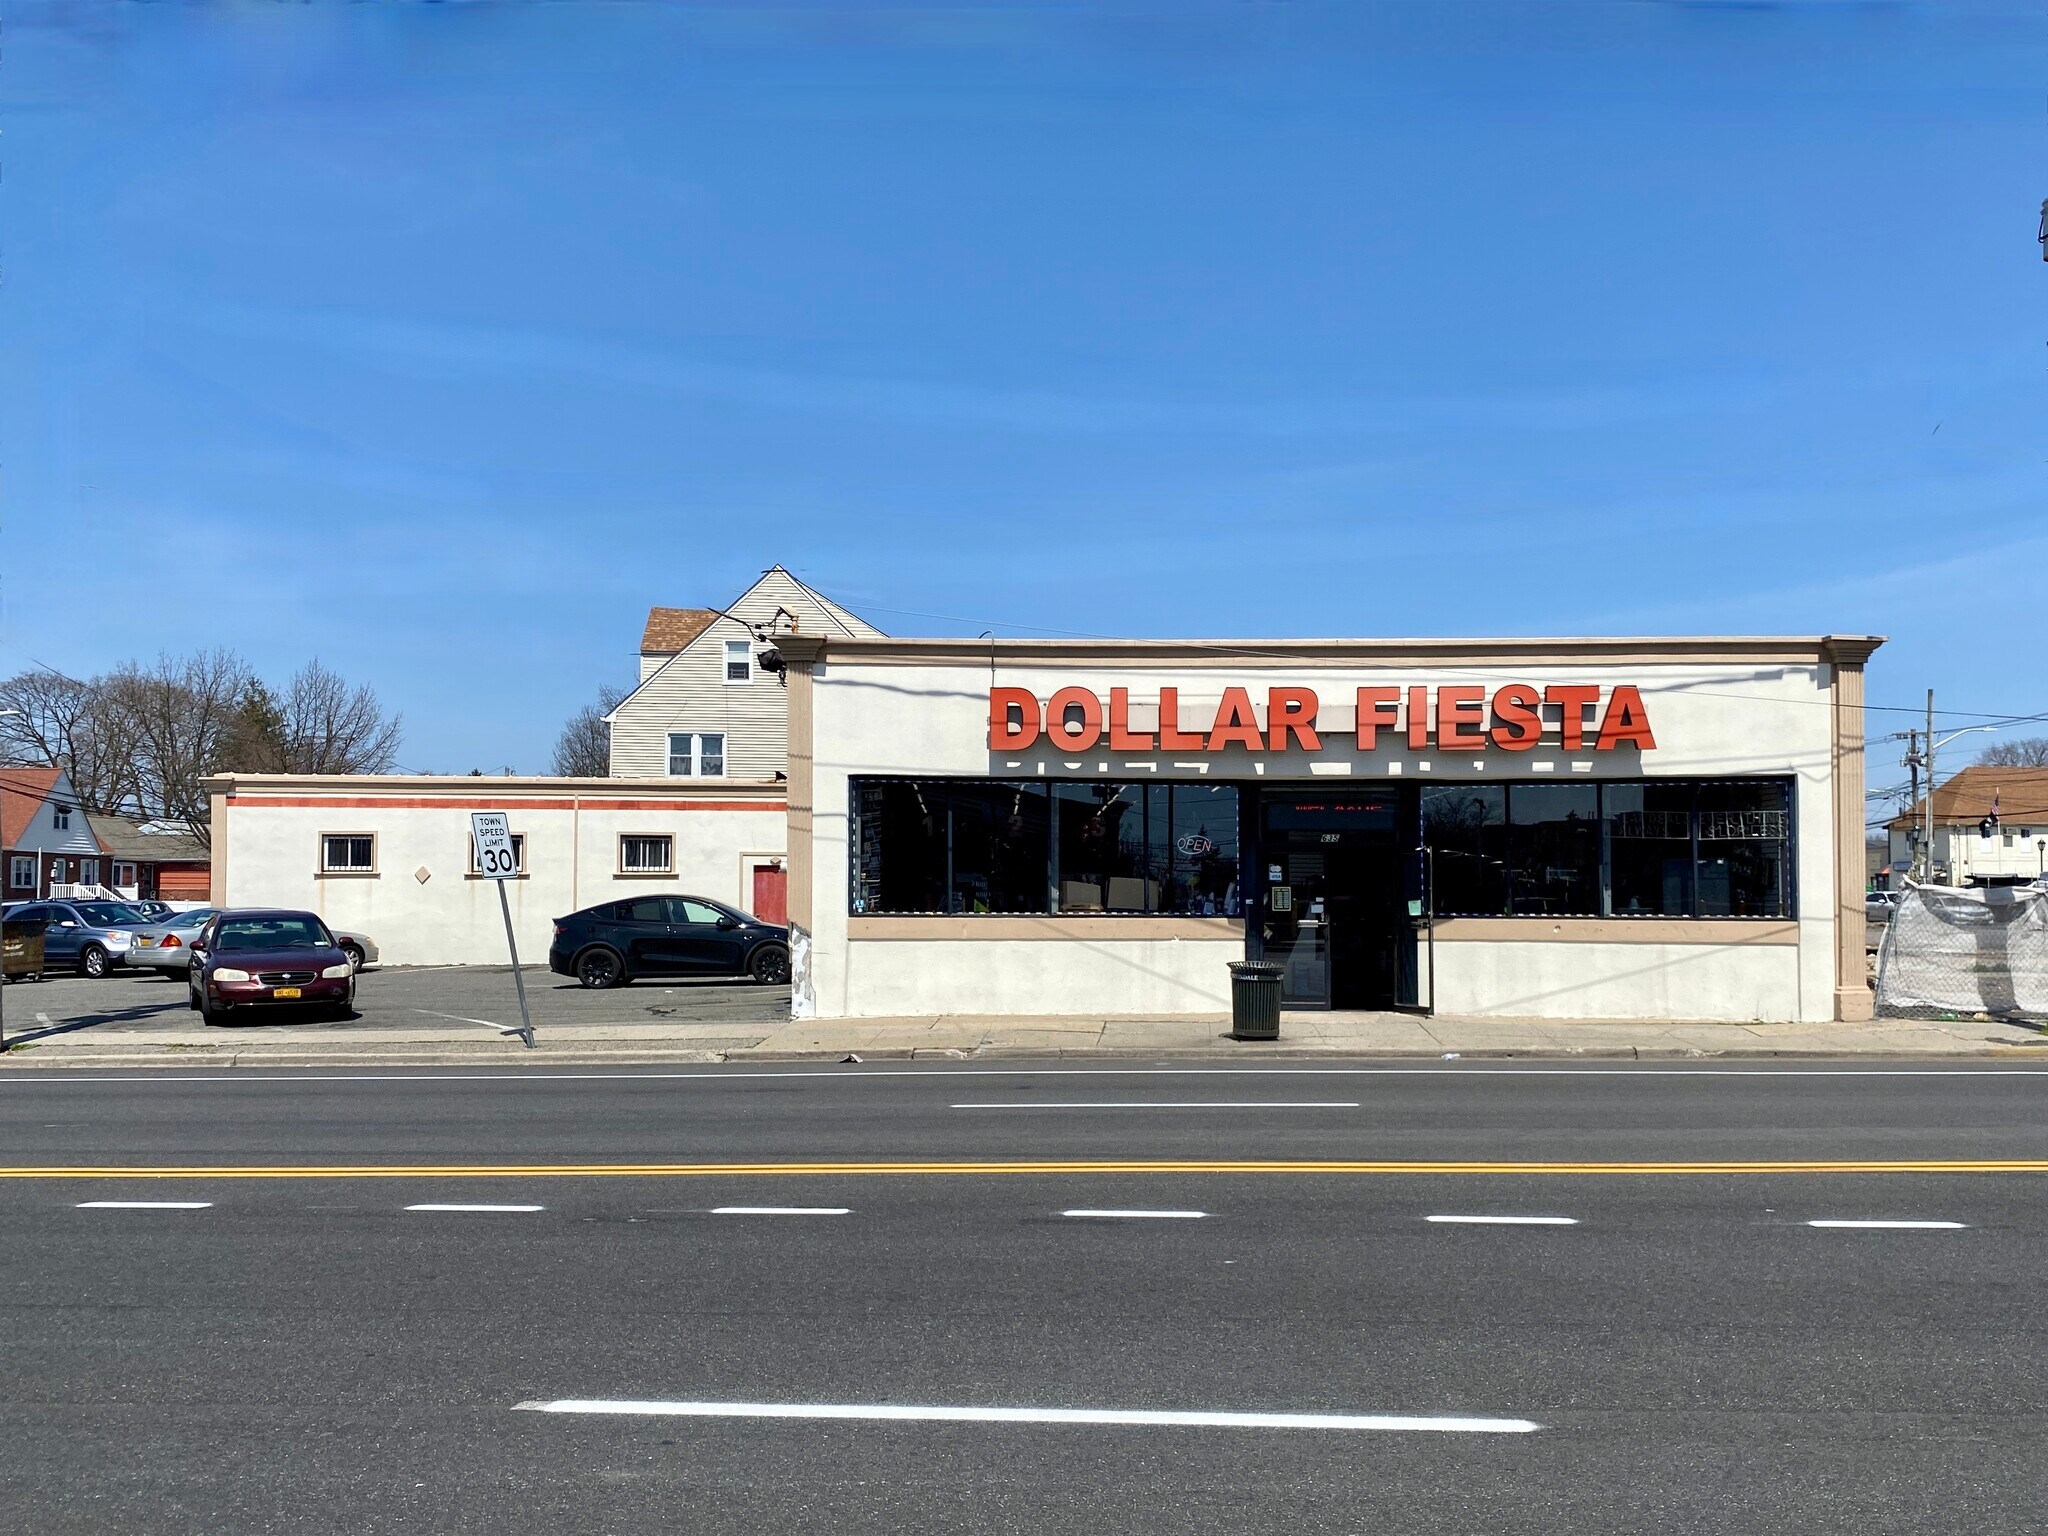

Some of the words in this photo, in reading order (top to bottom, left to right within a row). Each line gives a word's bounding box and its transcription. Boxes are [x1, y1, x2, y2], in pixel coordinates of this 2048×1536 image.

[989, 686, 1323, 752] DOLLAR
[1356, 684, 1658, 752] FIESTA
[479, 818, 501, 826] TOWN
[479, 828, 505, 837] SPEED
[484, 838, 504, 847] LIMIT
[1321, 834, 1339, 842] 635
[1177, 837, 1212, 852] OPEN
[483, 848, 513, 873] 30
